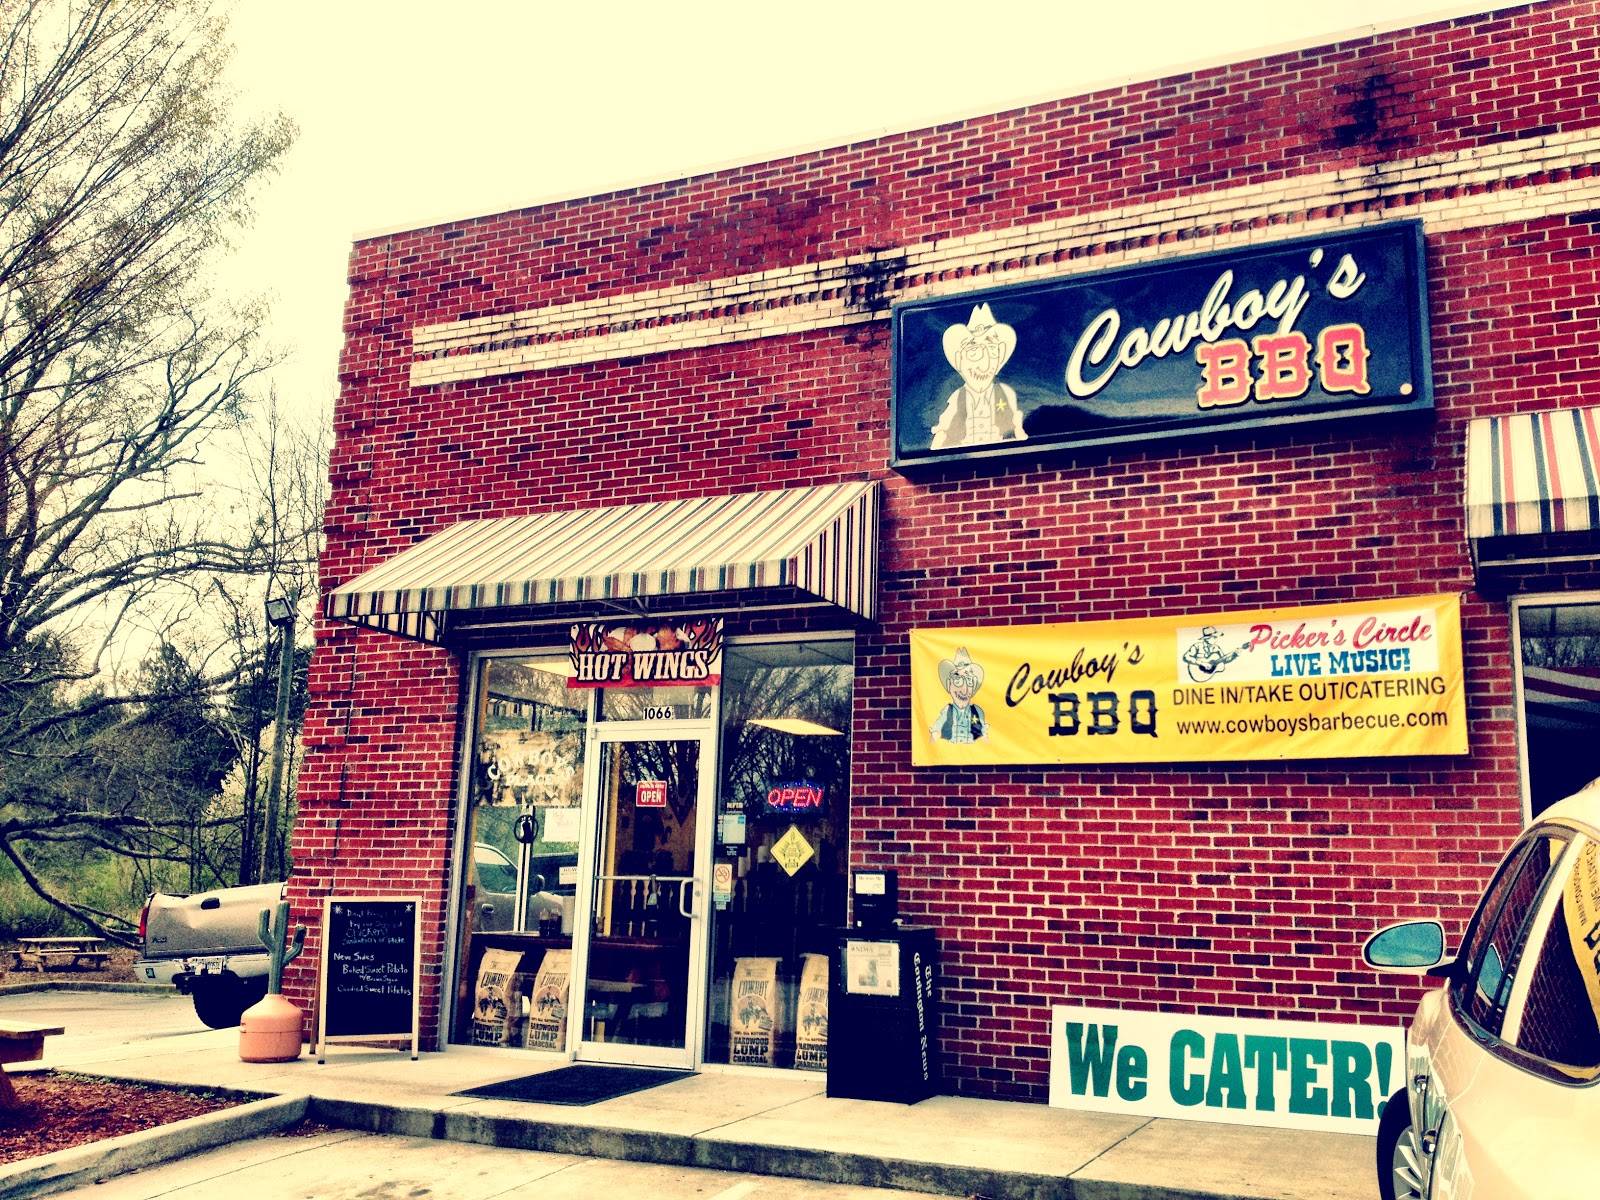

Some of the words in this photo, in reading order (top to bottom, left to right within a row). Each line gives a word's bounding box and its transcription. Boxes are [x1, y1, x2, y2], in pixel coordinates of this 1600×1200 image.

[1065, 248, 1366, 397] Cowboy's
[1197, 322, 1371, 408] BBQ
[1249, 619, 1347, 652] Picker's
[1352, 615, 1432, 649] Circle
[578, 653, 627, 681] HOT
[632, 651, 709, 680] WINGS
[1005, 642, 1144, 707] Cowboy's
[1271, 652, 1322, 677] LIVE
[1328, 648, 1411, 674] MUSIC!
[1173, 688, 1214, 706] DINE
[1221, 685, 1297, 704] IN/TAKE
[1299, 676, 1446, 701] OUT/CATERING
[643, 706, 672, 720] 1066
[1048, 690, 1158, 738] BBQ
[1176, 711, 1449, 737] www.cowboysbarbecue.com
[641, 789, 662, 803] OPEN
[767, 787, 823, 807] OPEN
[529, 1032, 557, 1041] LUMP
[733, 1045, 769, 1056] LUMP
[733, 1055, 768, 1064] CHARCOAL
[797, 1050, 827, 1061] LUMP
[1065, 1021, 1148, 1102] We
[1169, 1028, 1394, 1120] CATER!
